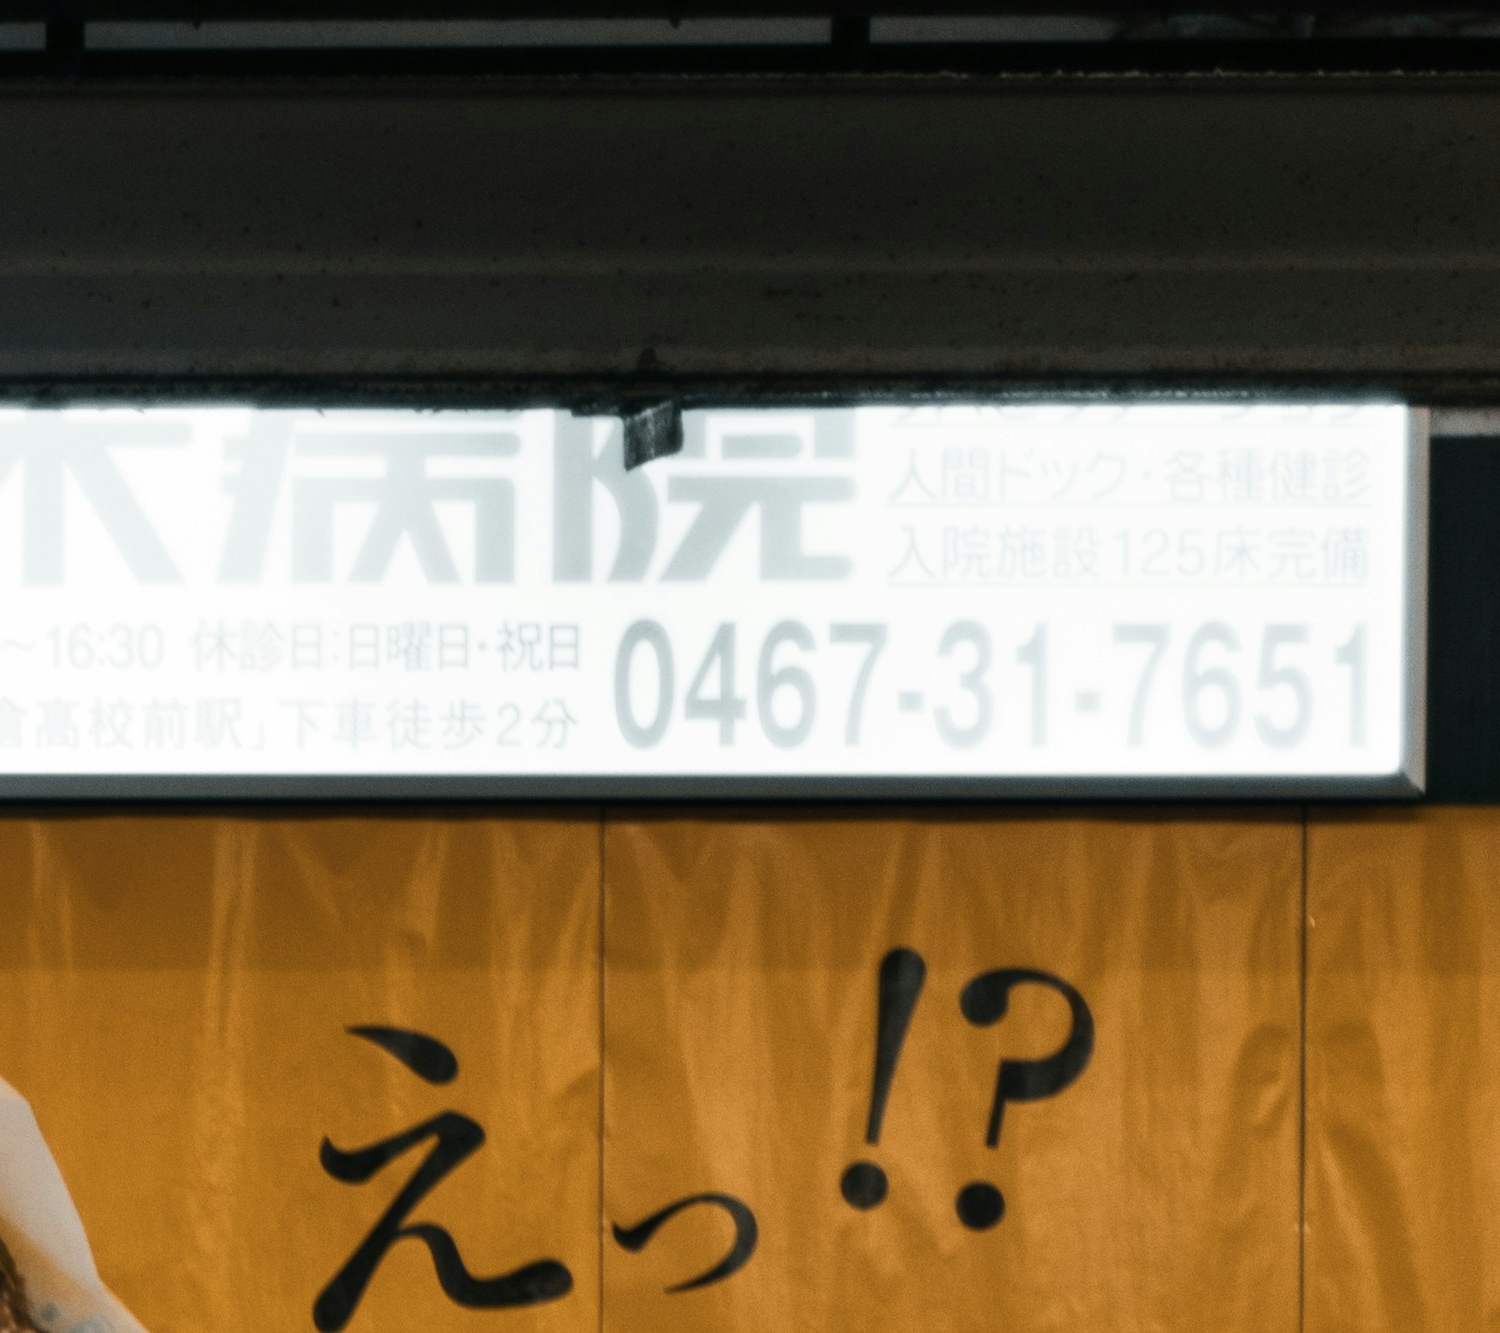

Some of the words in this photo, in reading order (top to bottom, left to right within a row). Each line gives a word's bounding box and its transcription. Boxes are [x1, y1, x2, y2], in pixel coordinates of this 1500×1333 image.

[888, 447, 1372, 502] 人間ドック・各種健診
[888, 525, 1369, 580] 入院施設125床完備
[614, 617, 1371, 750] 0467-31-7651
